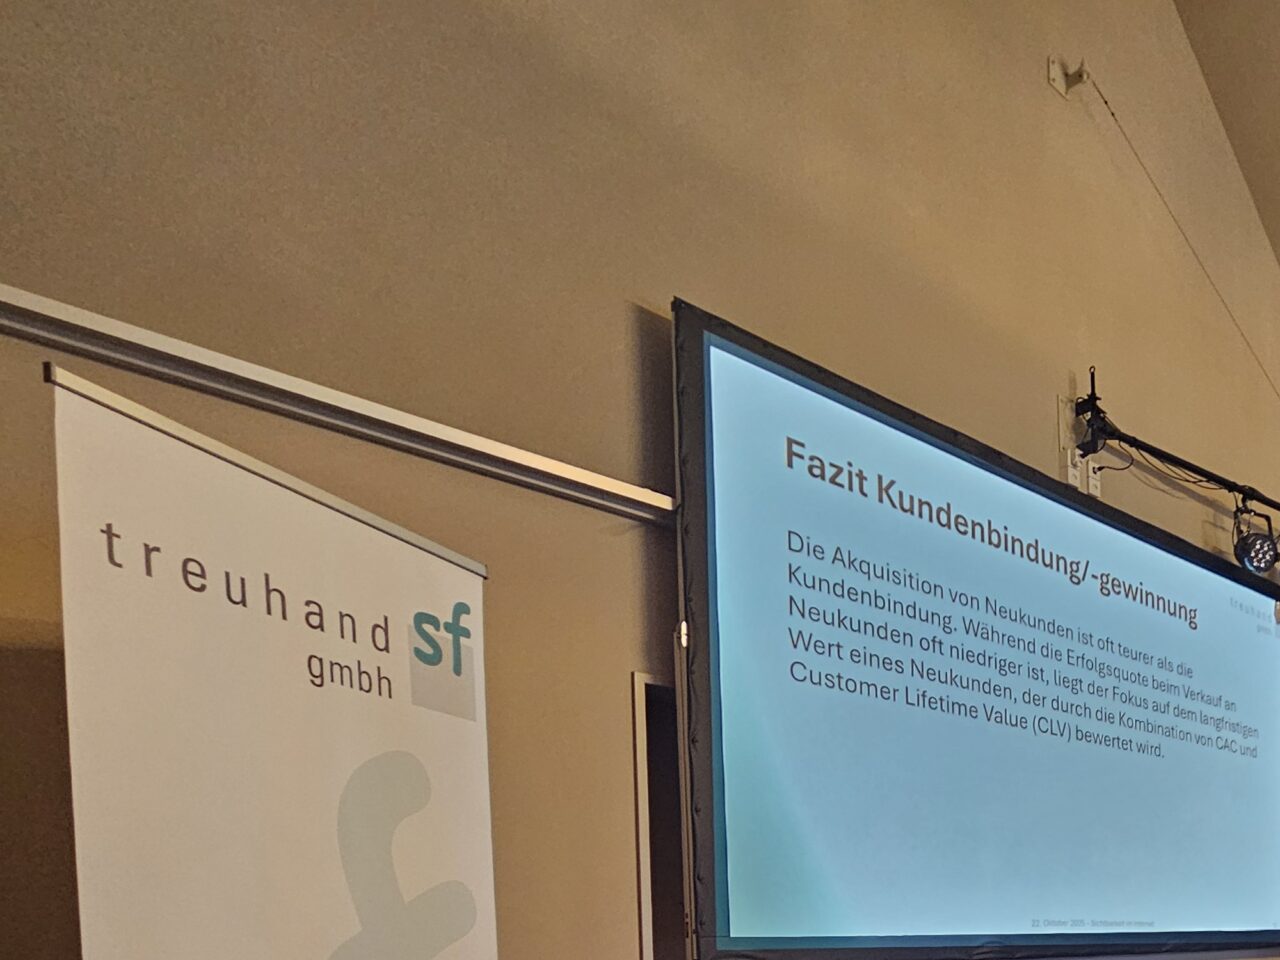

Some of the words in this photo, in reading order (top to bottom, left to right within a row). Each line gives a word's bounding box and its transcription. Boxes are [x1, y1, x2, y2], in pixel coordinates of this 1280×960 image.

[100, 522, 391, 654] treuhand
[786, 436, 868, 498] Fazit
[877, 473, 1198, 630] Kundenbindung/-gewinnung
[412, 601, 472, 677] sf
[787, 530, 825, 560] Die
[831, 546, 944, 599] Akquisition
[948, 587, 980, 611] von
[985, 596, 1074, 641] Neukunden
[1077, 626, 1094, 647] ist
[1097, 636, 1115, 654] oft
[1117, 642, 1154, 666] teurer
[1157, 656, 1174, 673] als
[1176, 662, 1194, 679] die
[788, 562, 958, 635] Kundenbindung.
[962, 615, 1036, 654] Während
[1040, 641, 1063, 662] die
[1066, 648, 1149, 687] Erfolgsquote
[1151, 675, 1180, 697] beim
[1182, 684, 1223, 707] Verkauf
[1224, 698, 1237, 712] an
[789, 595, 914, 648] Neukunden
[919, 635, 945, 656] oft
[950, 643, 1023, 677] niedriger
[1027, 661, 1049, 686] ist,
[1053, 668, 1084, 695] liegt
[1087, 679, 1109, 698] der
[1112, 685, 1149, 710] Fokus
[1151, 698, 1171, 714] auf
[1173, 703, 1198, 722] dem
[1199, 710, 1260, 739] langfristigen
[307, 652, 394, 700] gmbh
[788, 626, 844, 661] Wert
[849, 645, 905, 675] eines
[910, 658, 1017, 704] Neukunden,
[1022, 687, 1047, 708] der
[1051, 695, 1092, 719] durch
[1095, 707, 1115, 725] die
[1118, 711, 1193, 742] Kombination
[1194, 733, 1214, 748] von
[1215, 735, 1238, 754] CAC
[1239, 745, 1258, 758] und
[789, 660, 900, 702] Customer
[905, 686, 979, 719] Lifetime
[983, 703, 1028, 730] Value
[1032, 714, 1072, 743] (CLV)
[1075, 725, 1133, 752] bewertet
[1136, 740, 1165, 759] wird.
